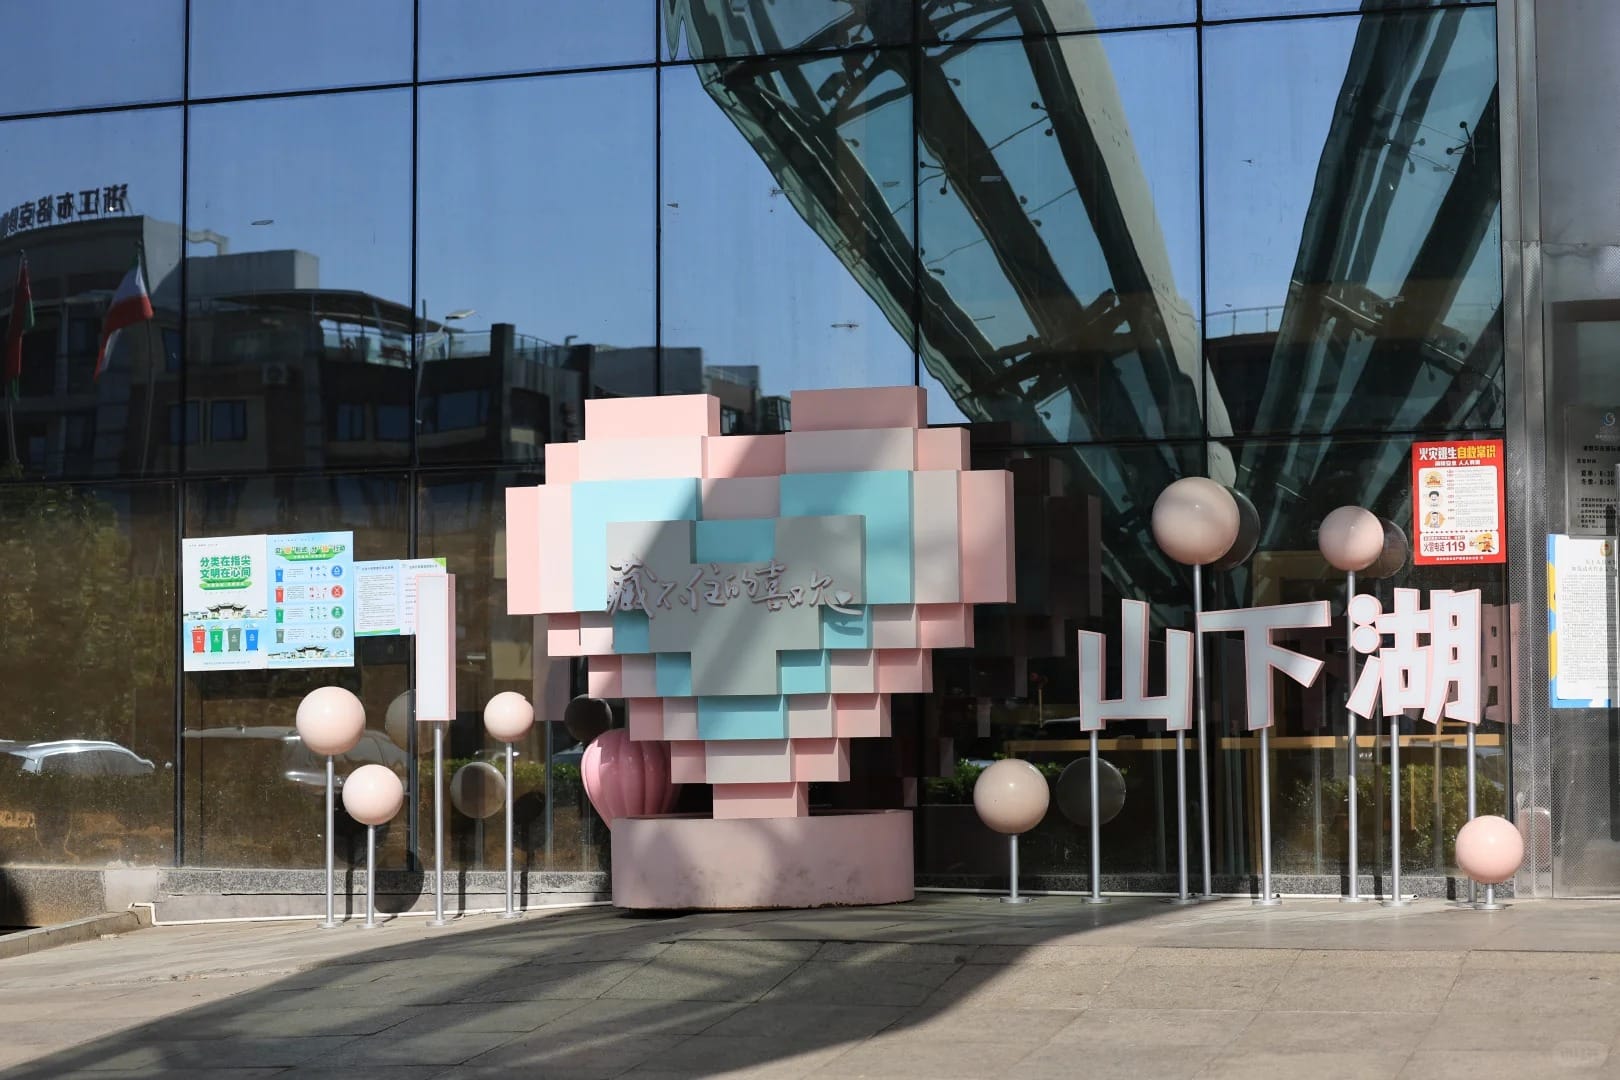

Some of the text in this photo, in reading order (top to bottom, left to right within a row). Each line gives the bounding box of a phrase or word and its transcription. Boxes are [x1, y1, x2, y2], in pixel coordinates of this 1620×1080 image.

[200, 554, 251, 567] 分类在指尖
[200, 566, 251, 579] 文明在心间
[607, 555, 864, 619] 藏不住的喜欢
[1078, 588, 1482, 731] 山下湖
